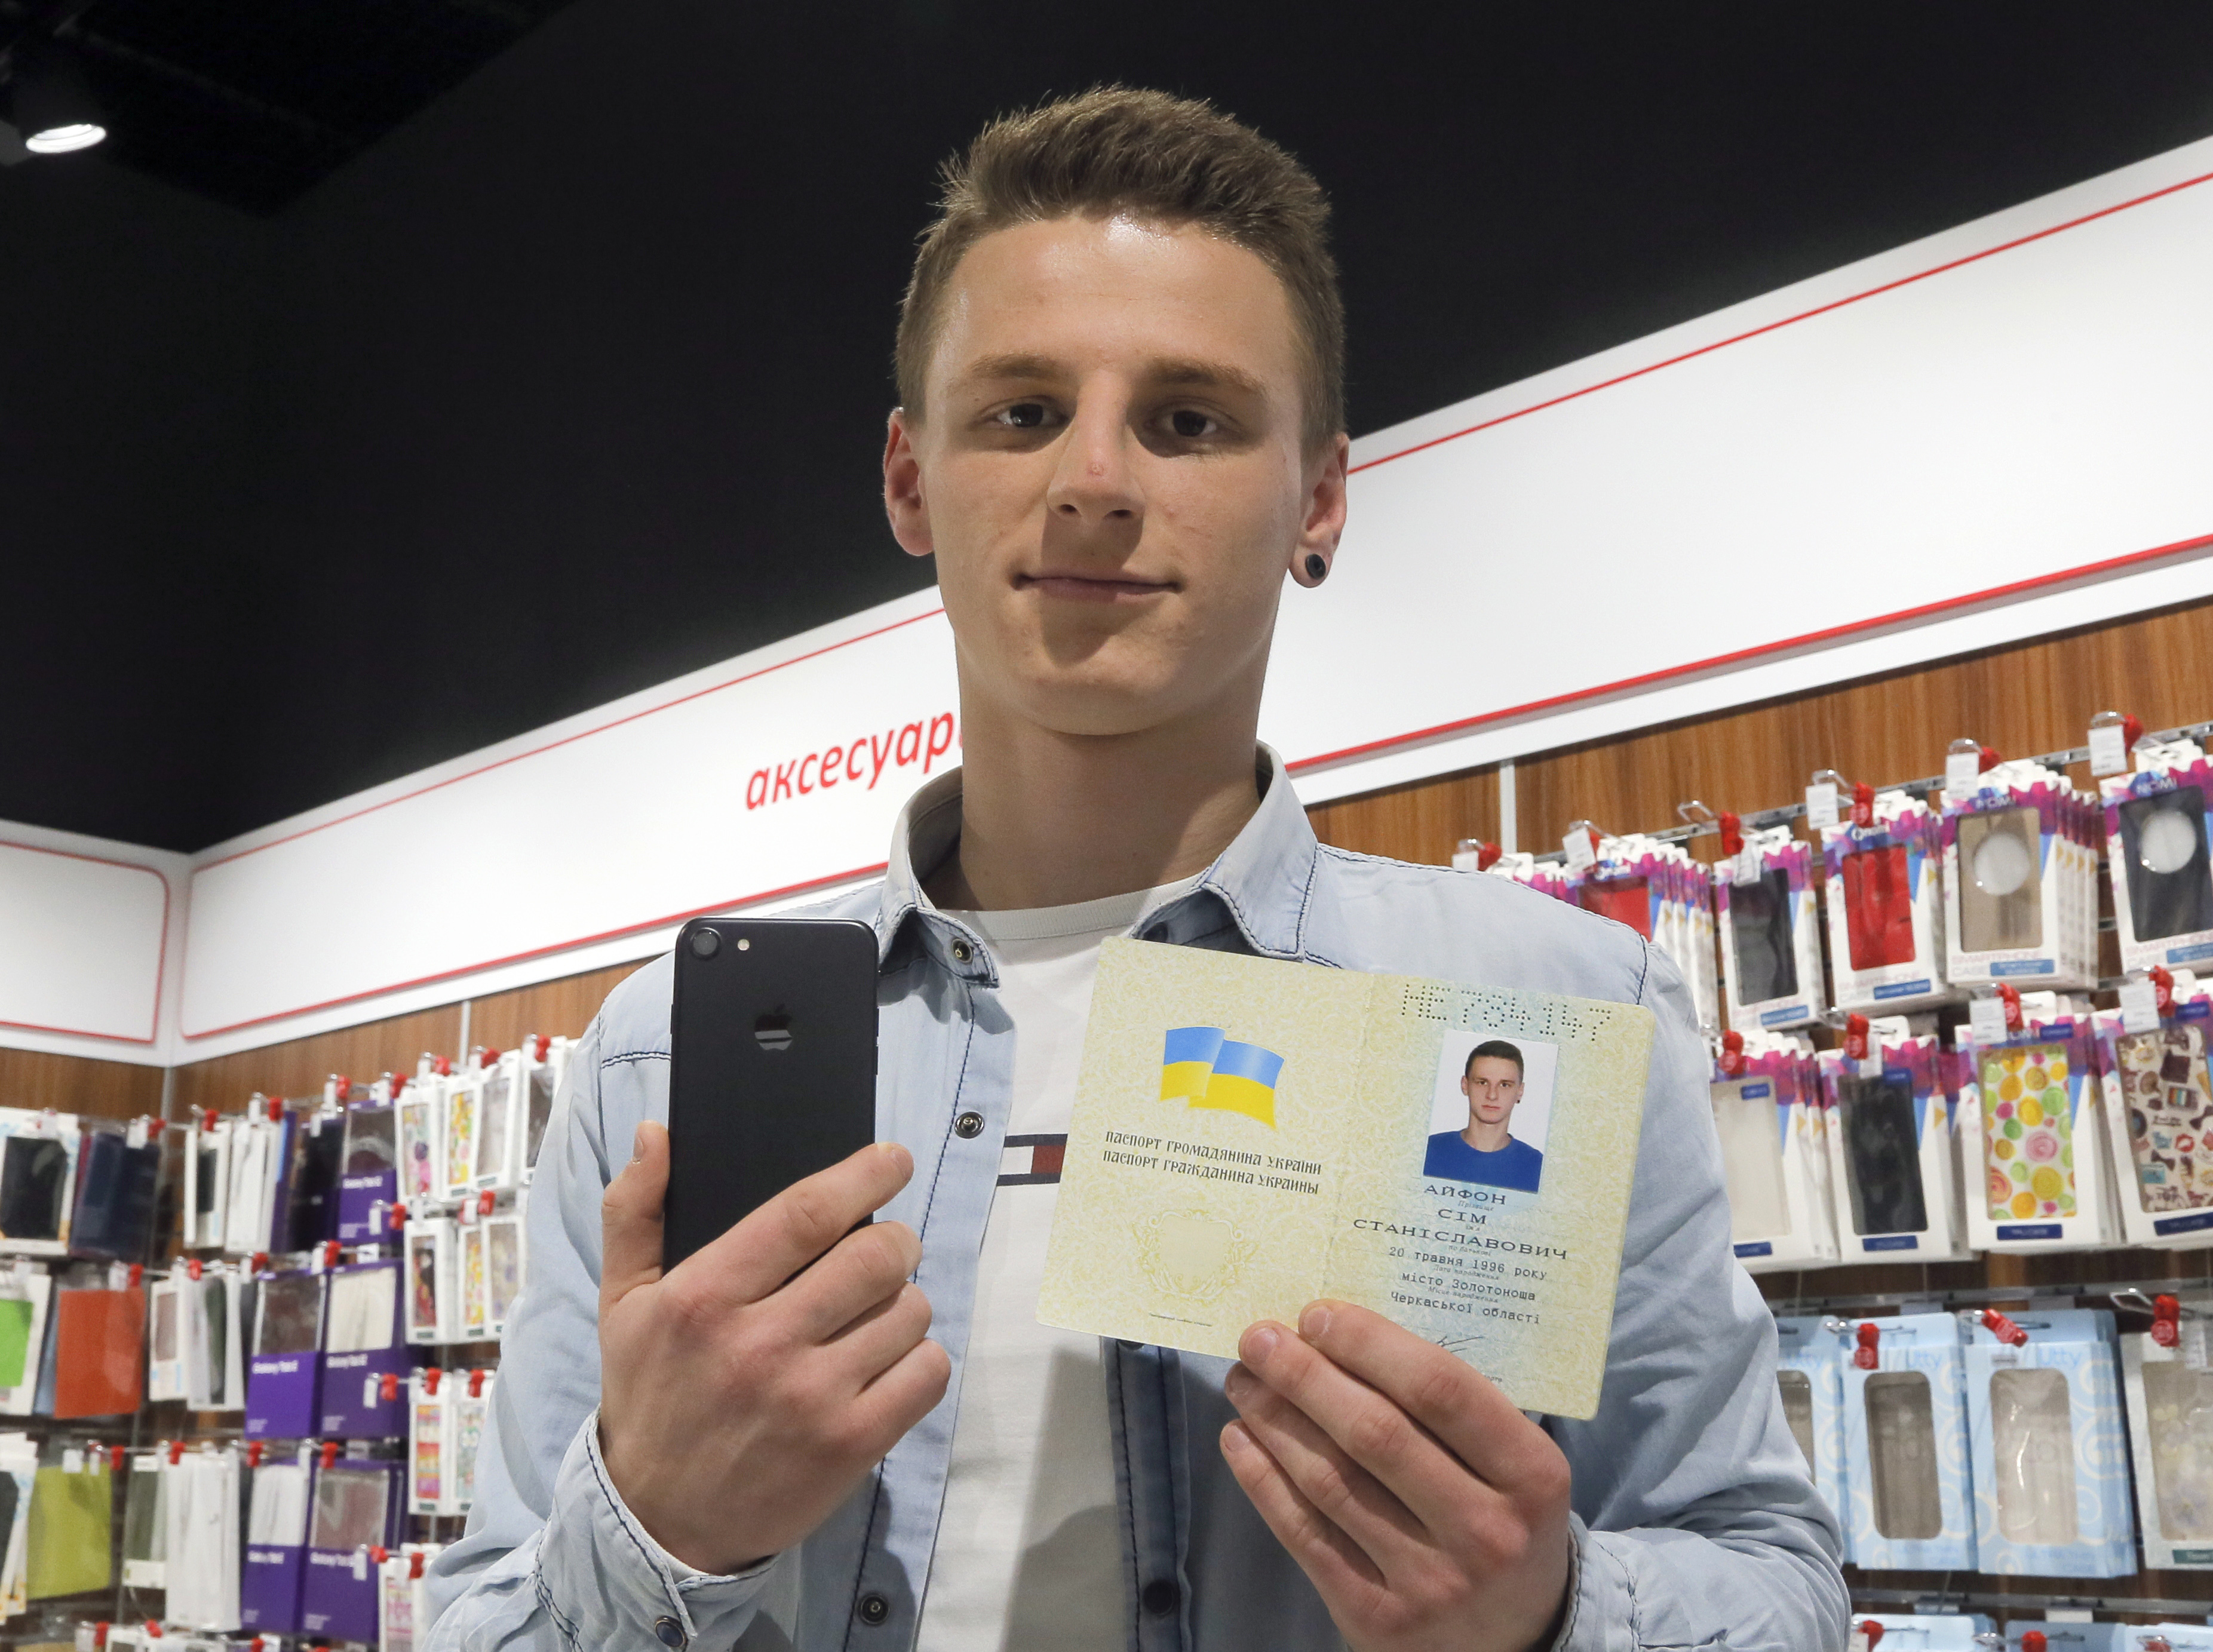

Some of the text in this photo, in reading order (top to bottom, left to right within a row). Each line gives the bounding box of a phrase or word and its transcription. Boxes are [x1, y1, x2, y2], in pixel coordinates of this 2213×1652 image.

[746, 711, 963, 811] аксесуар
[1461, 990, 1611, 1042] 784147
[1424, 1184, 1506, 1205] АЙФОН
[1438, 1209, 1487, 1225] СІМ
[1353, 1219, 1568, 1260] СТАНІСЛАВОВИЧ
[1389, 1246, 1548, 1281] 20 травня 1996 року
[1402, 1272, 1536, 1301] місто Золотоноша
[1391, 1291, 1540, 1324] Черкаської області
